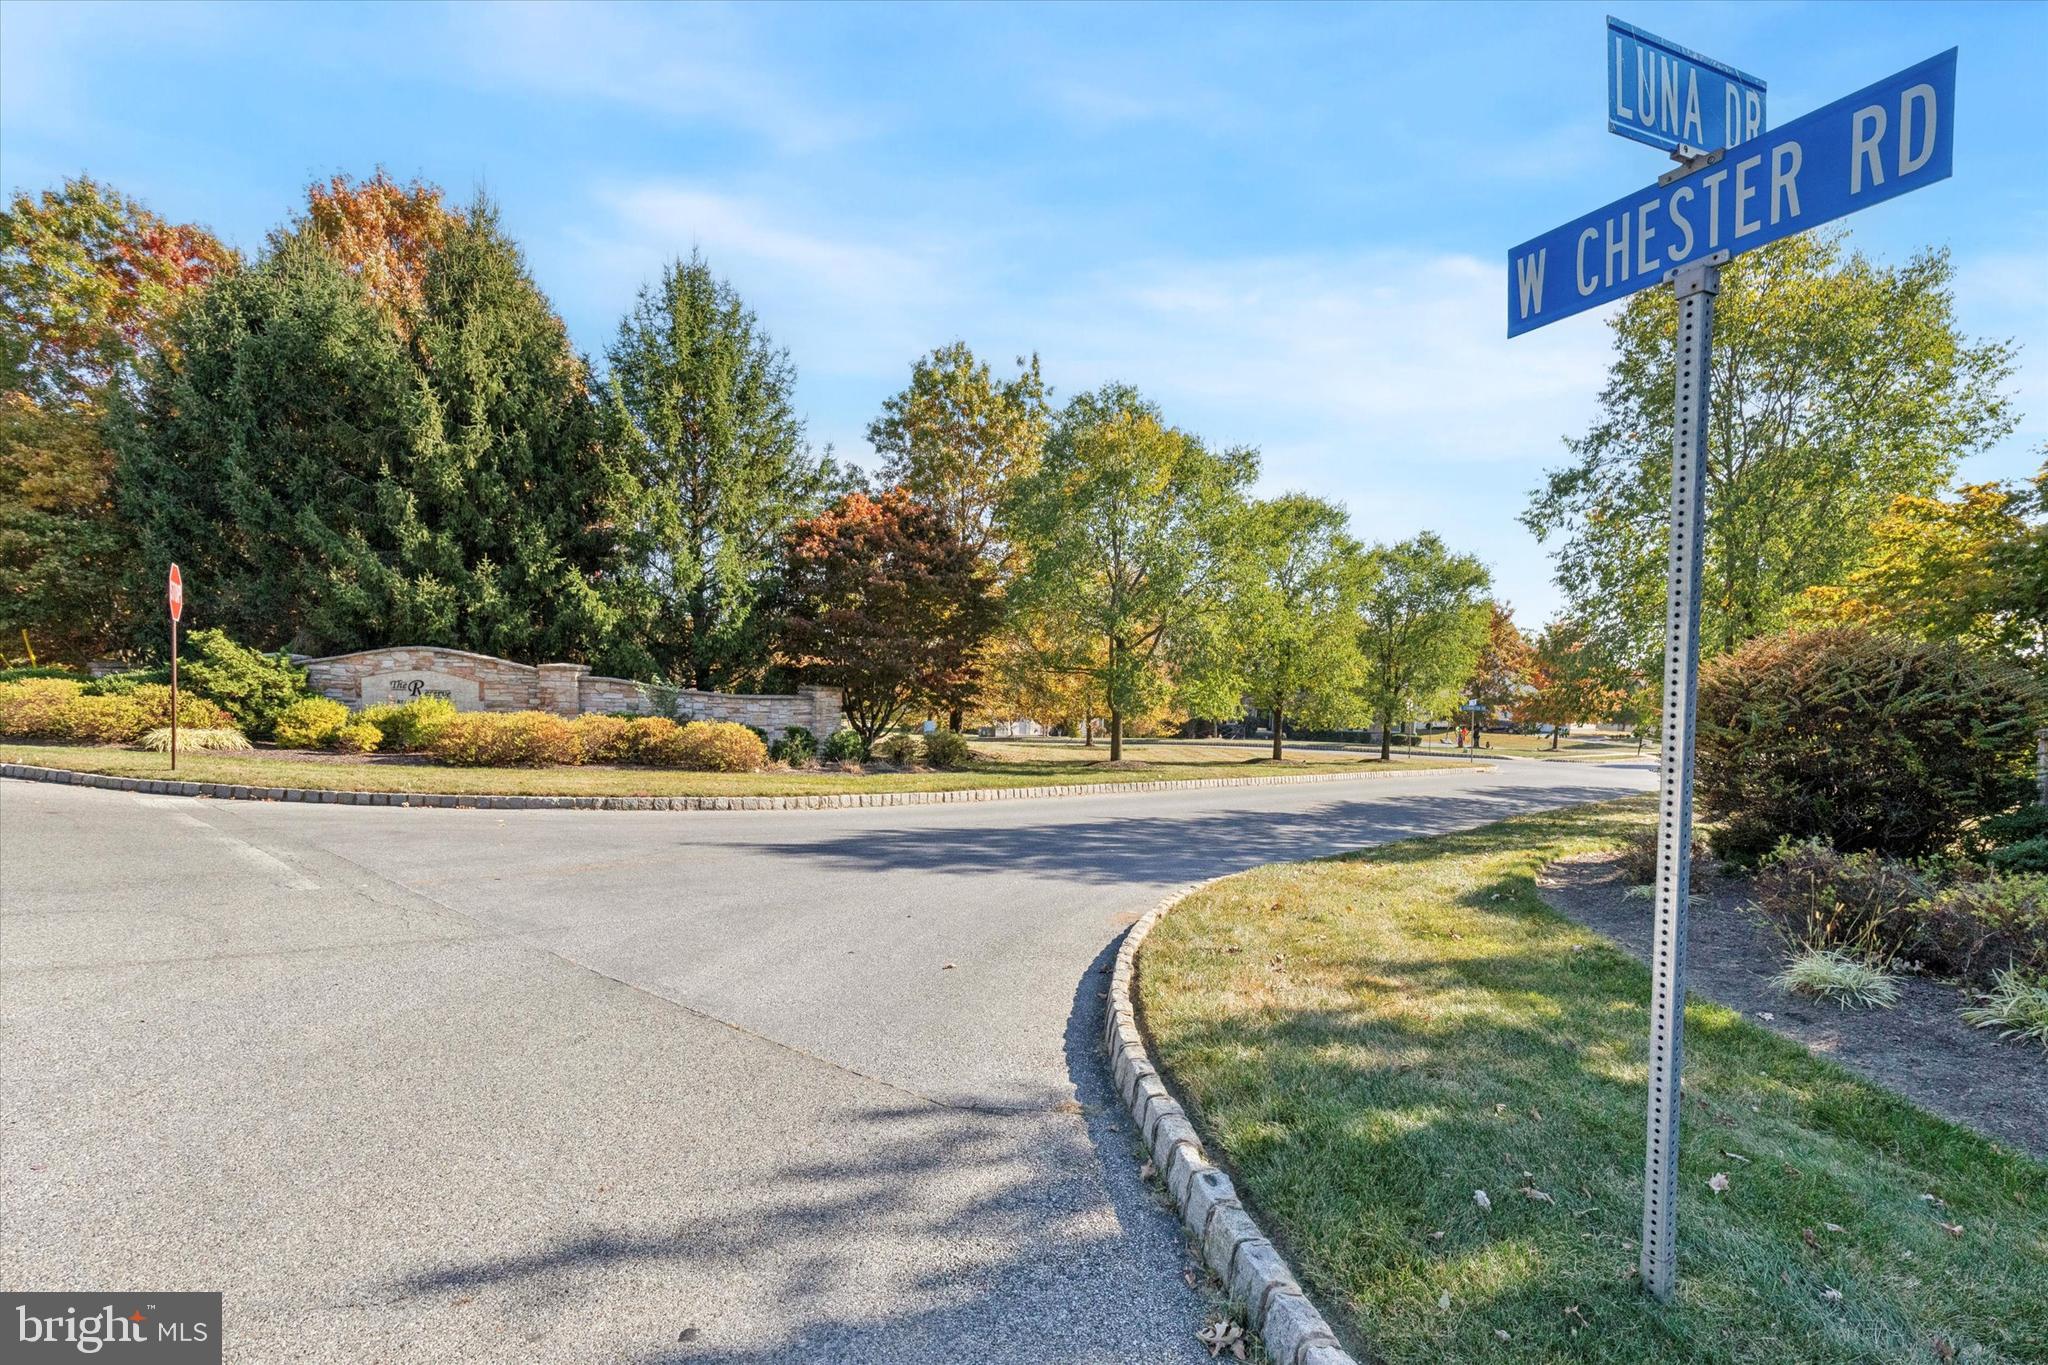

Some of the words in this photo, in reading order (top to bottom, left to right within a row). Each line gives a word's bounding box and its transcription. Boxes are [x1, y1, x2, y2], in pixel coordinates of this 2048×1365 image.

[1615, 36, 1704, 145] LUNA
[1725, 81, 1761, 150] DR
[1516, 247, 1547, 319] W
[1576, 140, 1803, 297] CHESTER
[1850, 83, 1938, 196] RD
[390, 679, 408, 691] The
